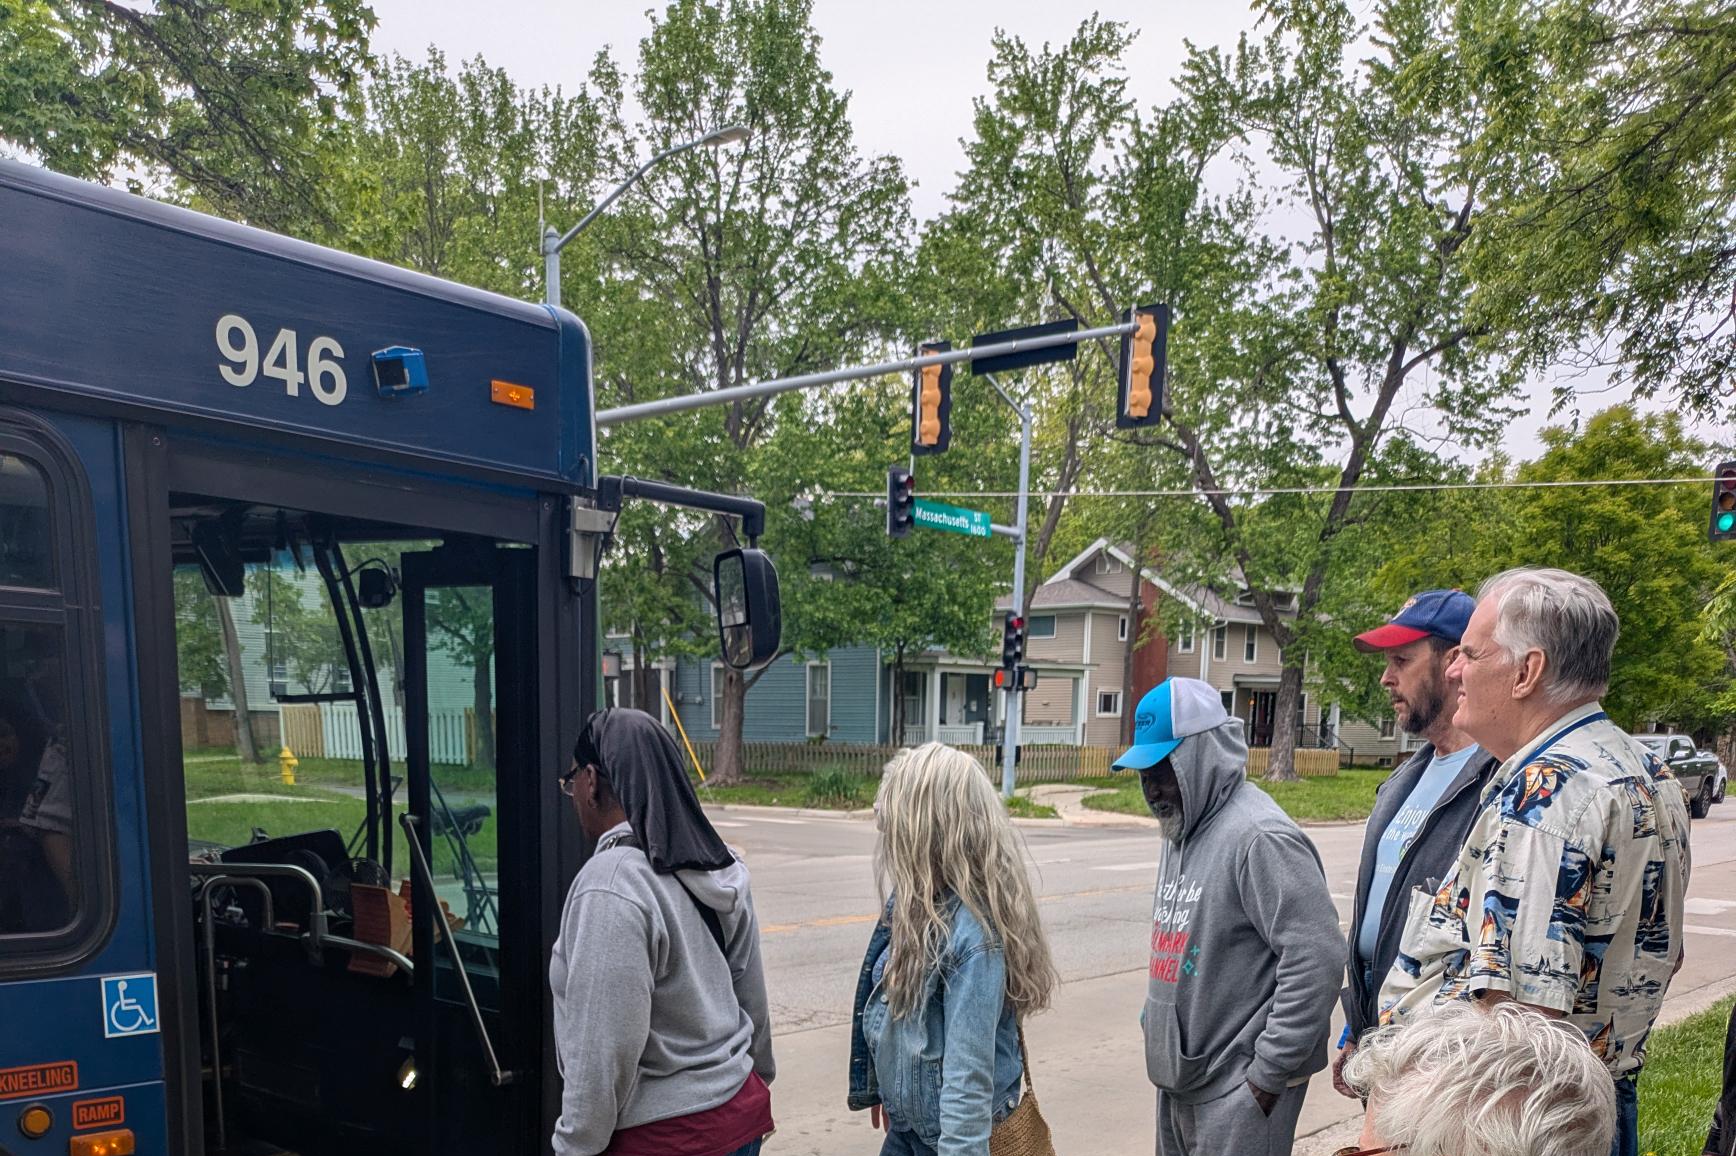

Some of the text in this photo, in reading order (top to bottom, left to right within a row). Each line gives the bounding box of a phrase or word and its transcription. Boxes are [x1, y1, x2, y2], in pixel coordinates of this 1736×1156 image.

[216, 314, 347, 405] 946
[915, 506, 969, 529] Massachusetts
[1396, 804, 1430, 830] Enjoy
[1184, 880, 1203, 902] be
[0, 1066, 72, 1093] KNEELING
[79, 1103, 119, 1123] RAMP
